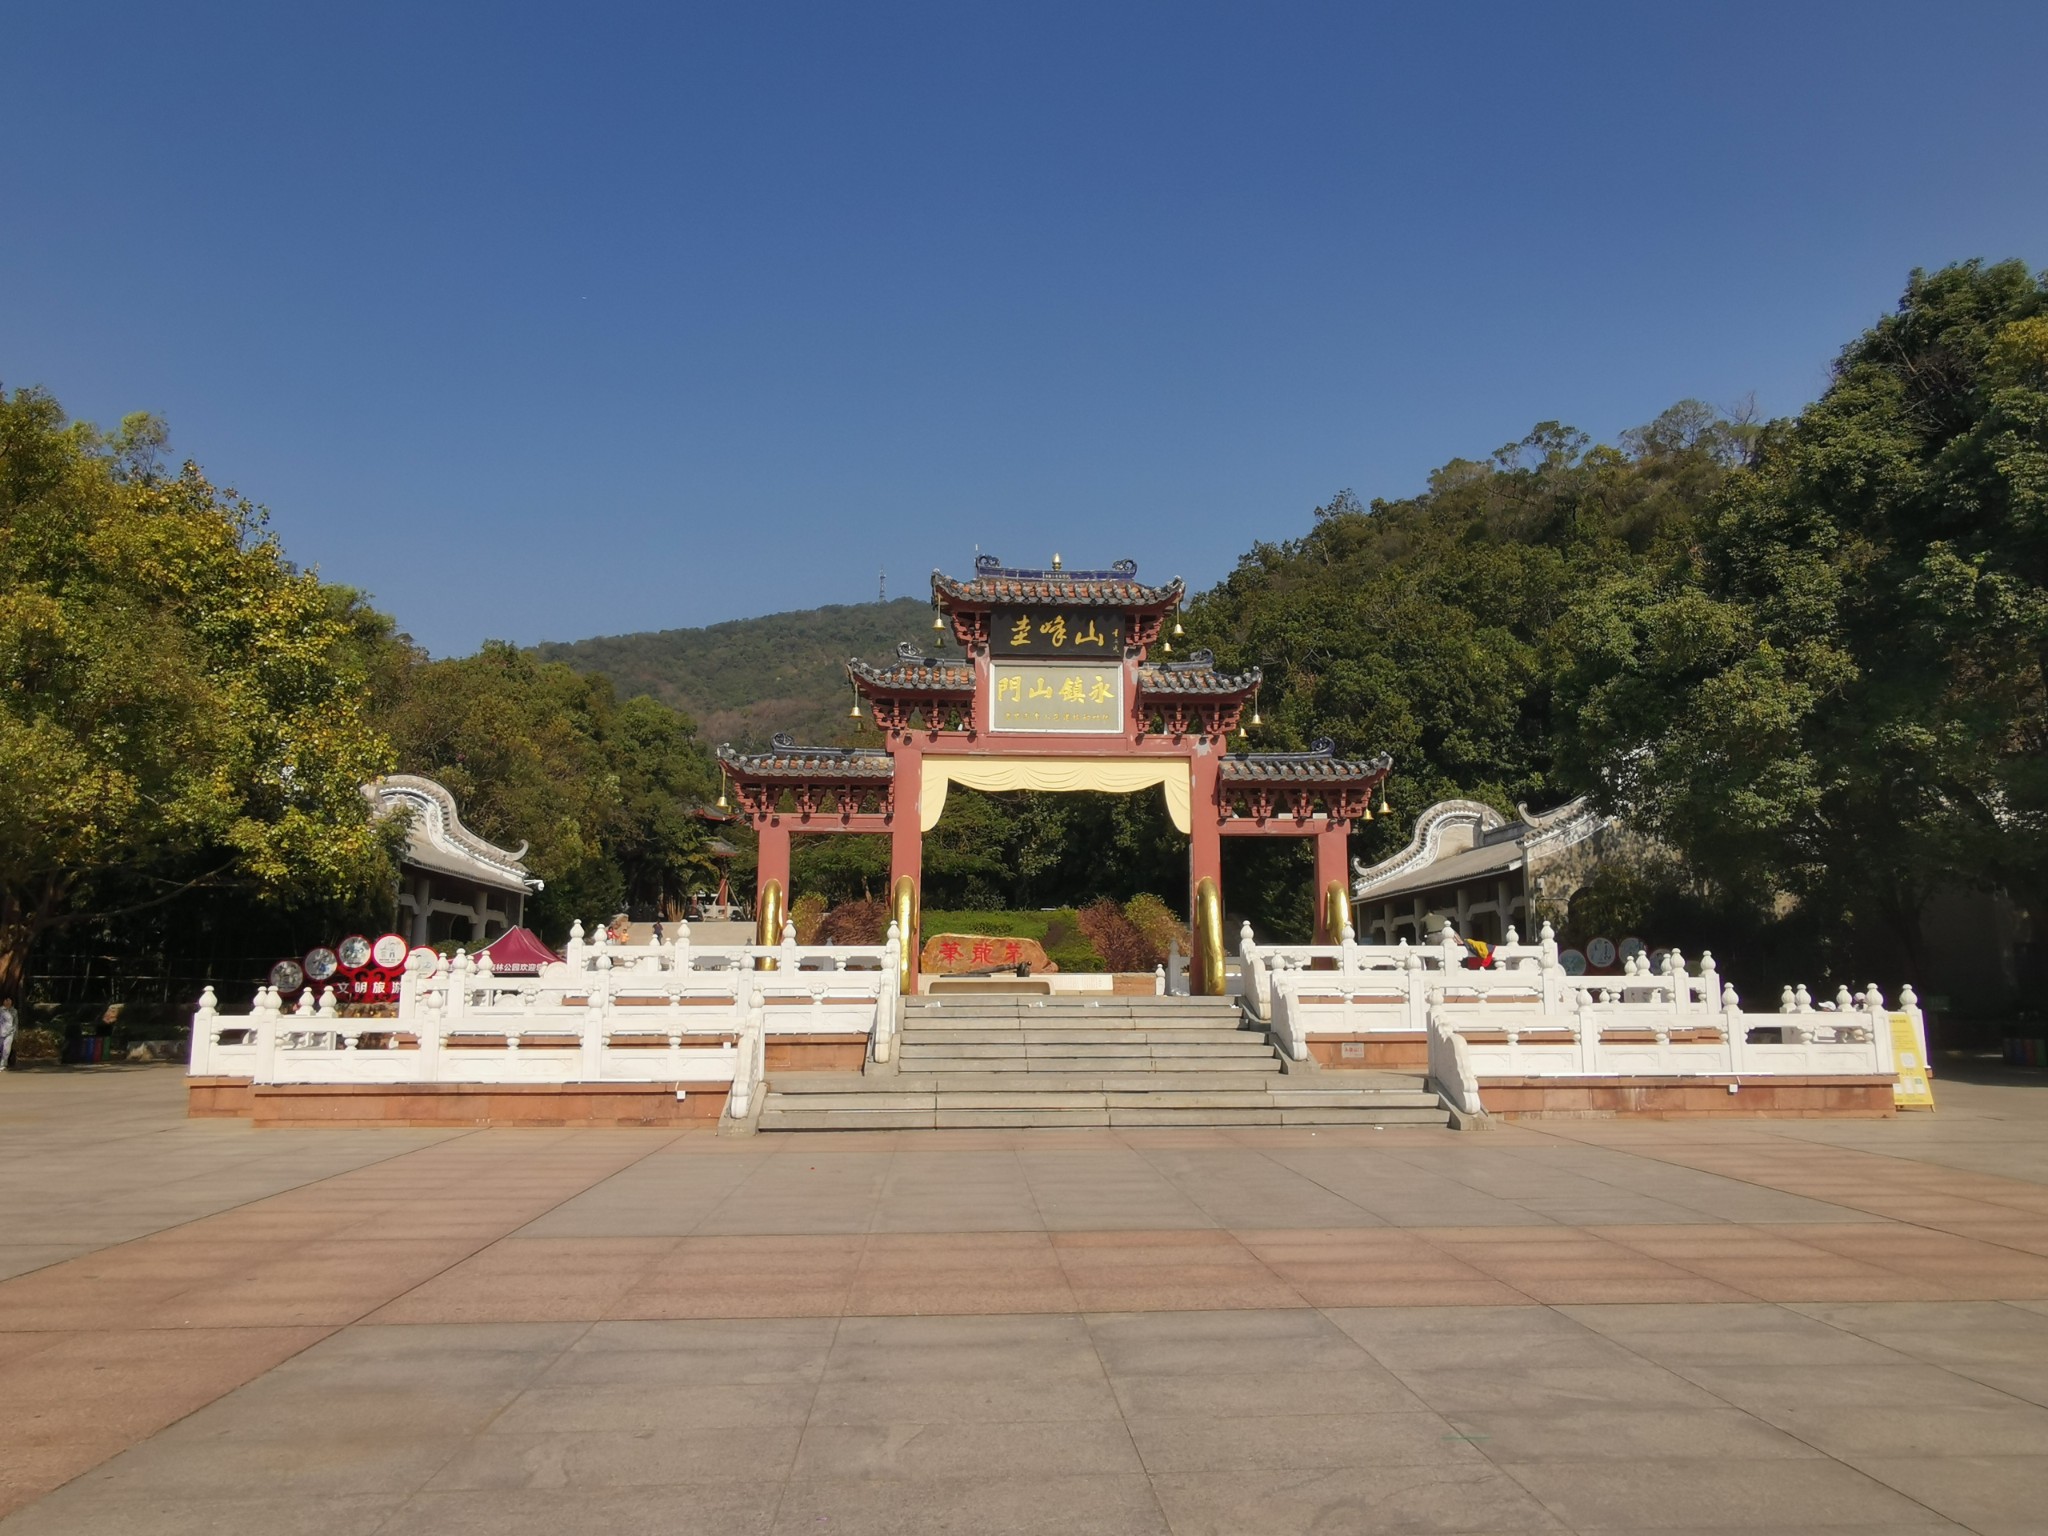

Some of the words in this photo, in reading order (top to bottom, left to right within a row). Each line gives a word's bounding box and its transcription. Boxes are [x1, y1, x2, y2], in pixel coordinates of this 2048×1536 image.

[1010, 614, 1105, 647] 圭峰山
[336, 981, 401, 994] 文明旅游
